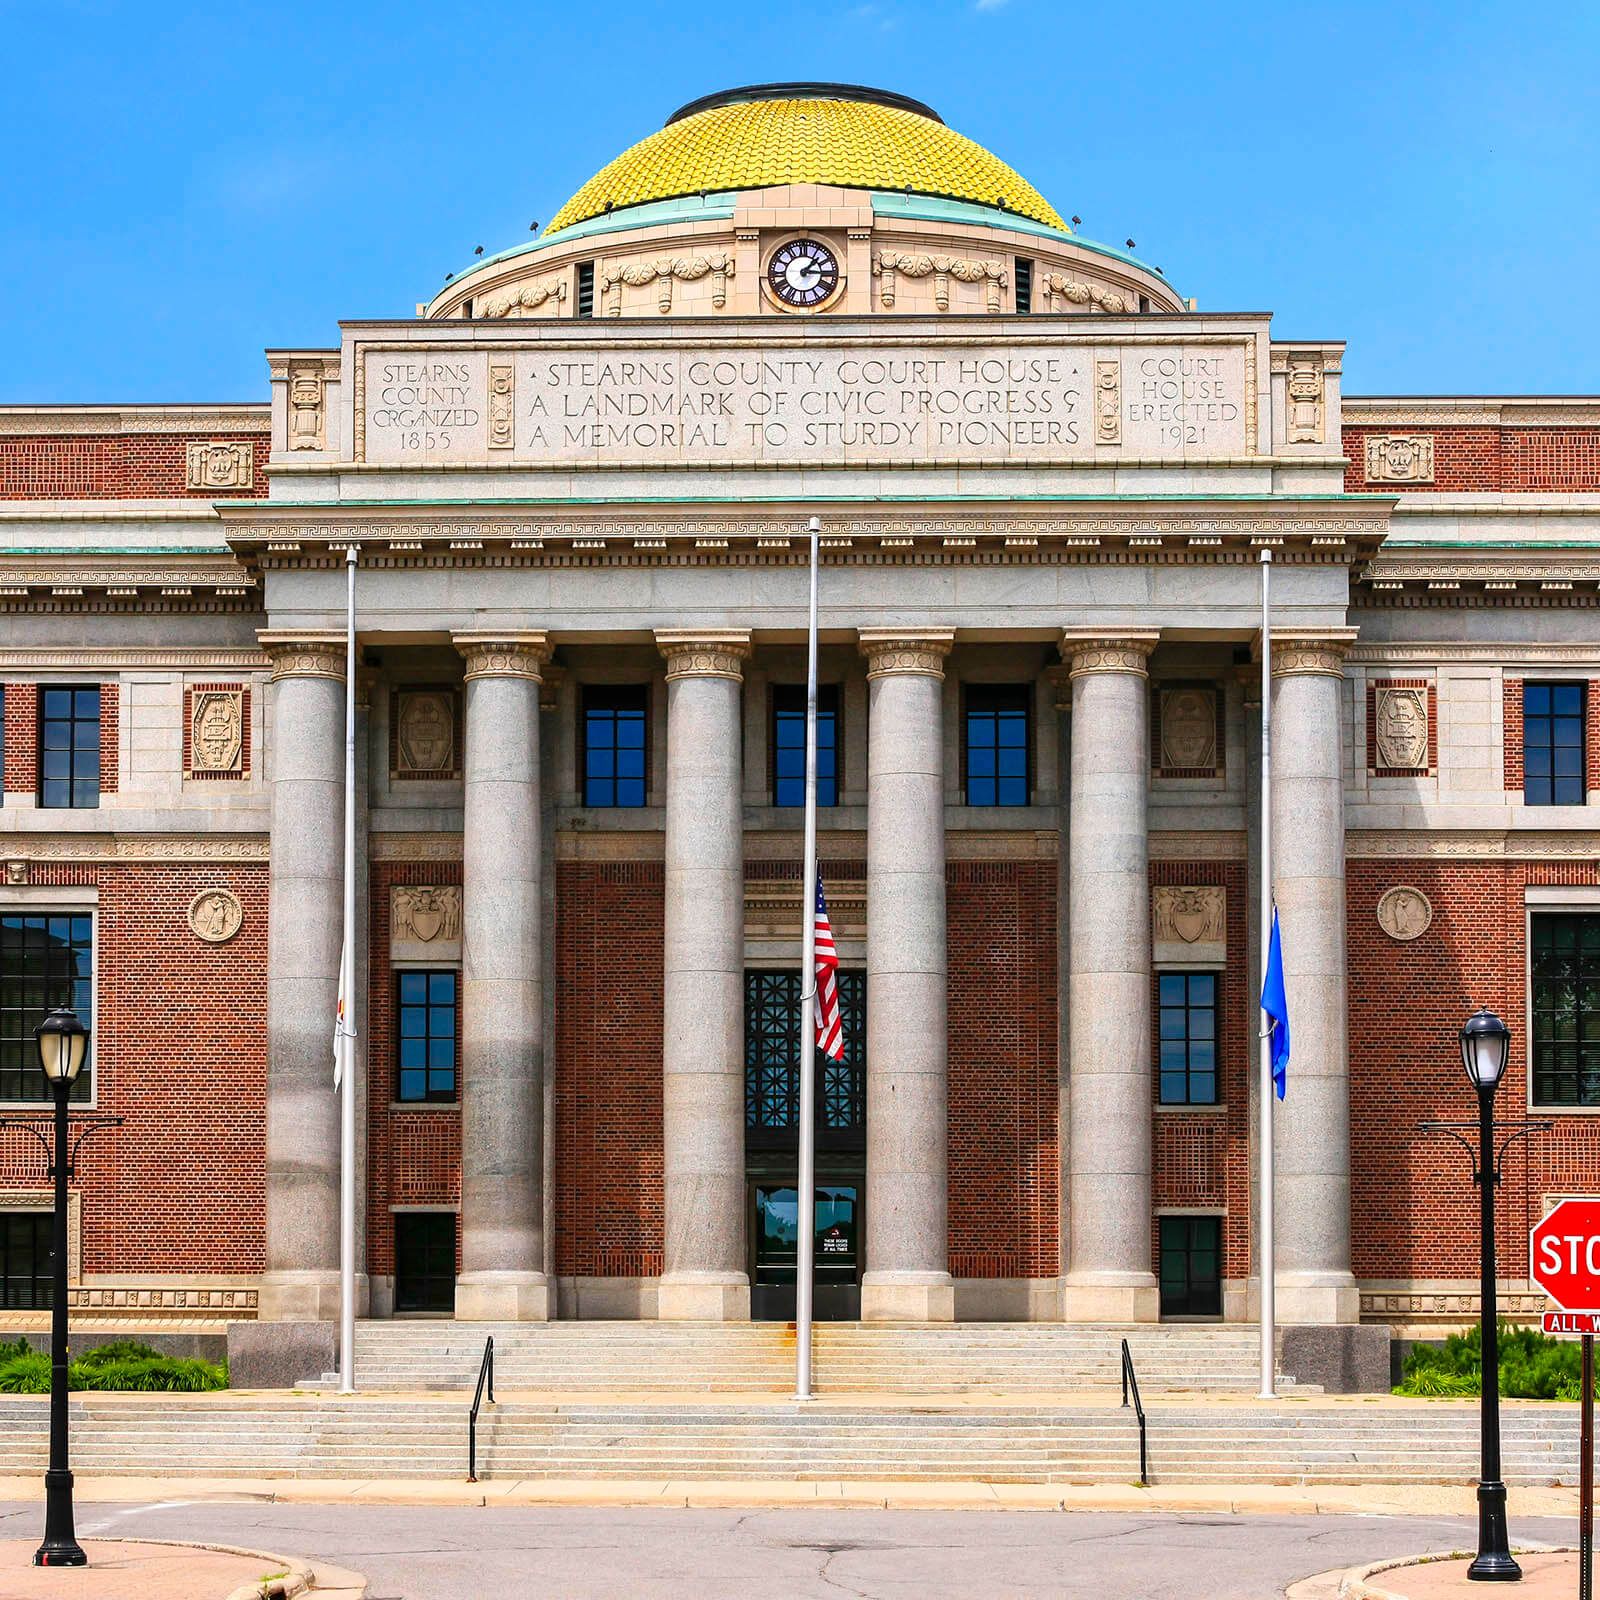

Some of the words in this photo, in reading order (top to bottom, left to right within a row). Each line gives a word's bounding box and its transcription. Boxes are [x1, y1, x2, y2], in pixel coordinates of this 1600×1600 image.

[382, 364, 470, 383] STEARNS
[547, 362, 674, 387] STEARNS
[688, 361, 824, 386] COUNTY
[837, 360, 946, 384] COURT
[960, 360, 1062, 383] HOUSE
[1141, 358, 1224, 377] COURT
[381, 387, 470, 405] COUNTY
[1142, 381, 1225, 399] HOUSE
[528, 395, 549, 417] A
[563, 392, 734, 417] LANDMARK
[748, 391, 788, 415] OF
[800, 390, 886, 415] CIVIC
[900, 390, 1053, 414] PROGRESS
[1129, 403, 1238, 421] ERECTED
[400, 431, 451, 449] 1855
[528, 425, 549, 447] A
[563, 423, 728, 448] MEMORIAL
[744, 422, 788, 446] TO
[803, 422, 920, 446] STURDY
[939, 421, 1079, 446] PIONEERS
[1160, 425, 1206, 449] 1921
[1550, 1314, 1582, 1332] ALL
